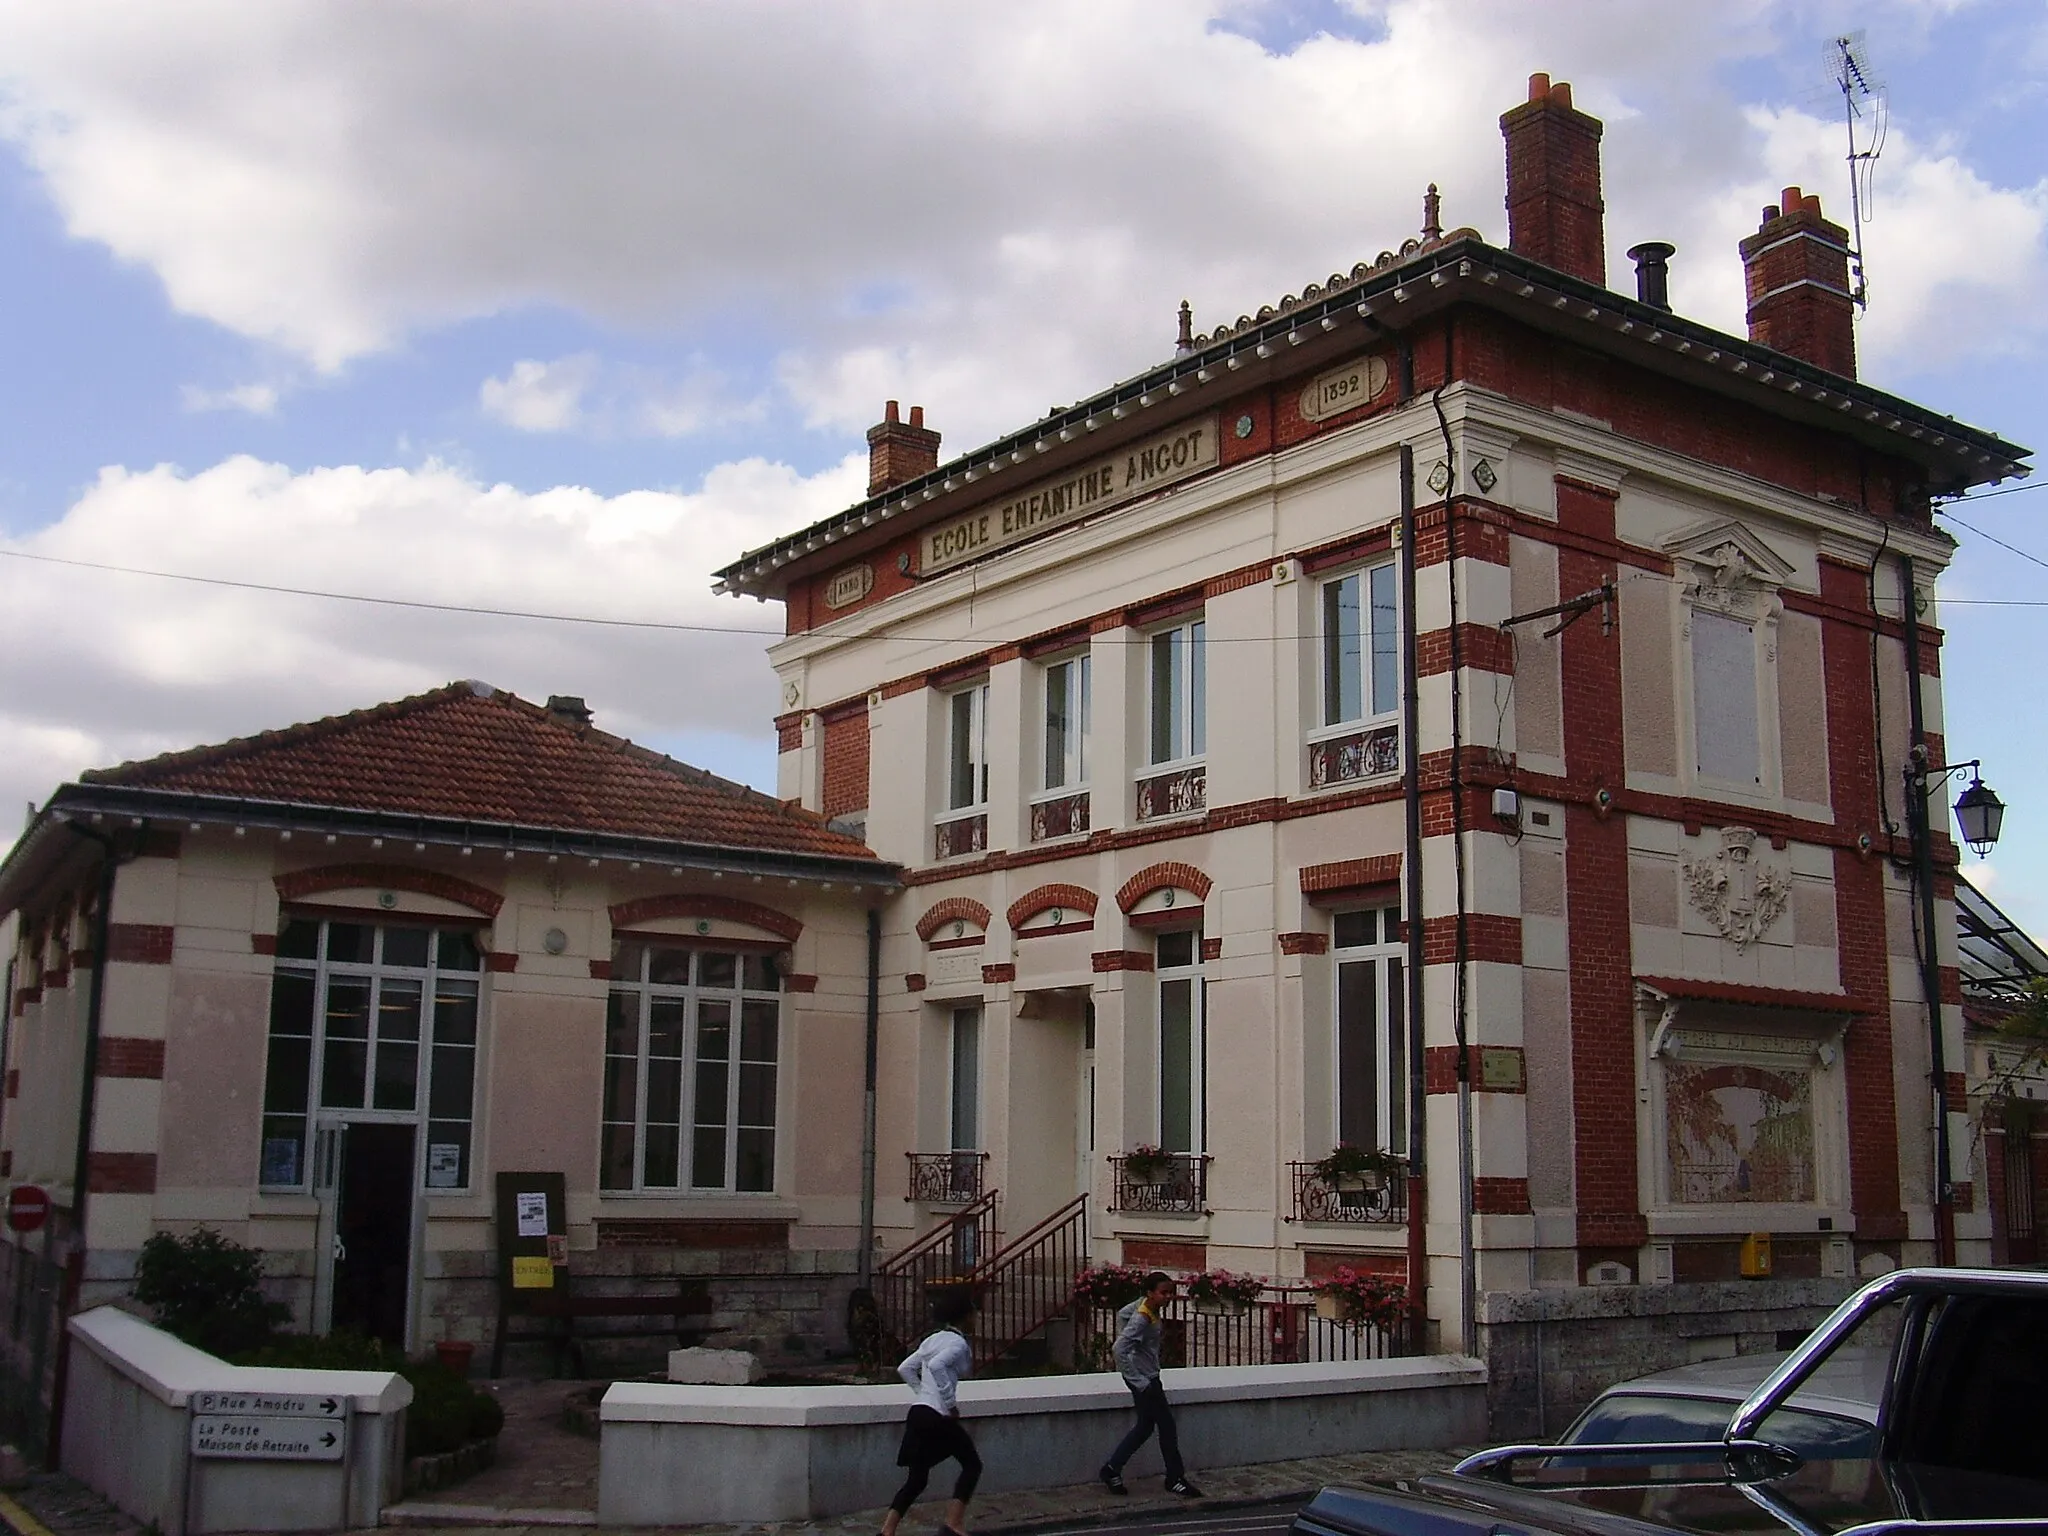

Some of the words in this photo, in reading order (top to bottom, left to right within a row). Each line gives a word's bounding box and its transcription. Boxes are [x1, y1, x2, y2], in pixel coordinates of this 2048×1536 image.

[1324, 375, 1359, 404] 1892
[931, 515, 989, 562] ECOLE
[1002, 465, 1114, 536] ENFANTINE
[1125, 430, 1203, 488] ANGOT
[220, 1396, 245, 1409] Rue
[199, 1423, 214, 1436] La
[221, 1423, 260, 1436] Poste
[198, 1438, 241, 1451] Maison
[245, 1439, 259, 1451] de
[262, 1439, 310, 1453] Retraite
